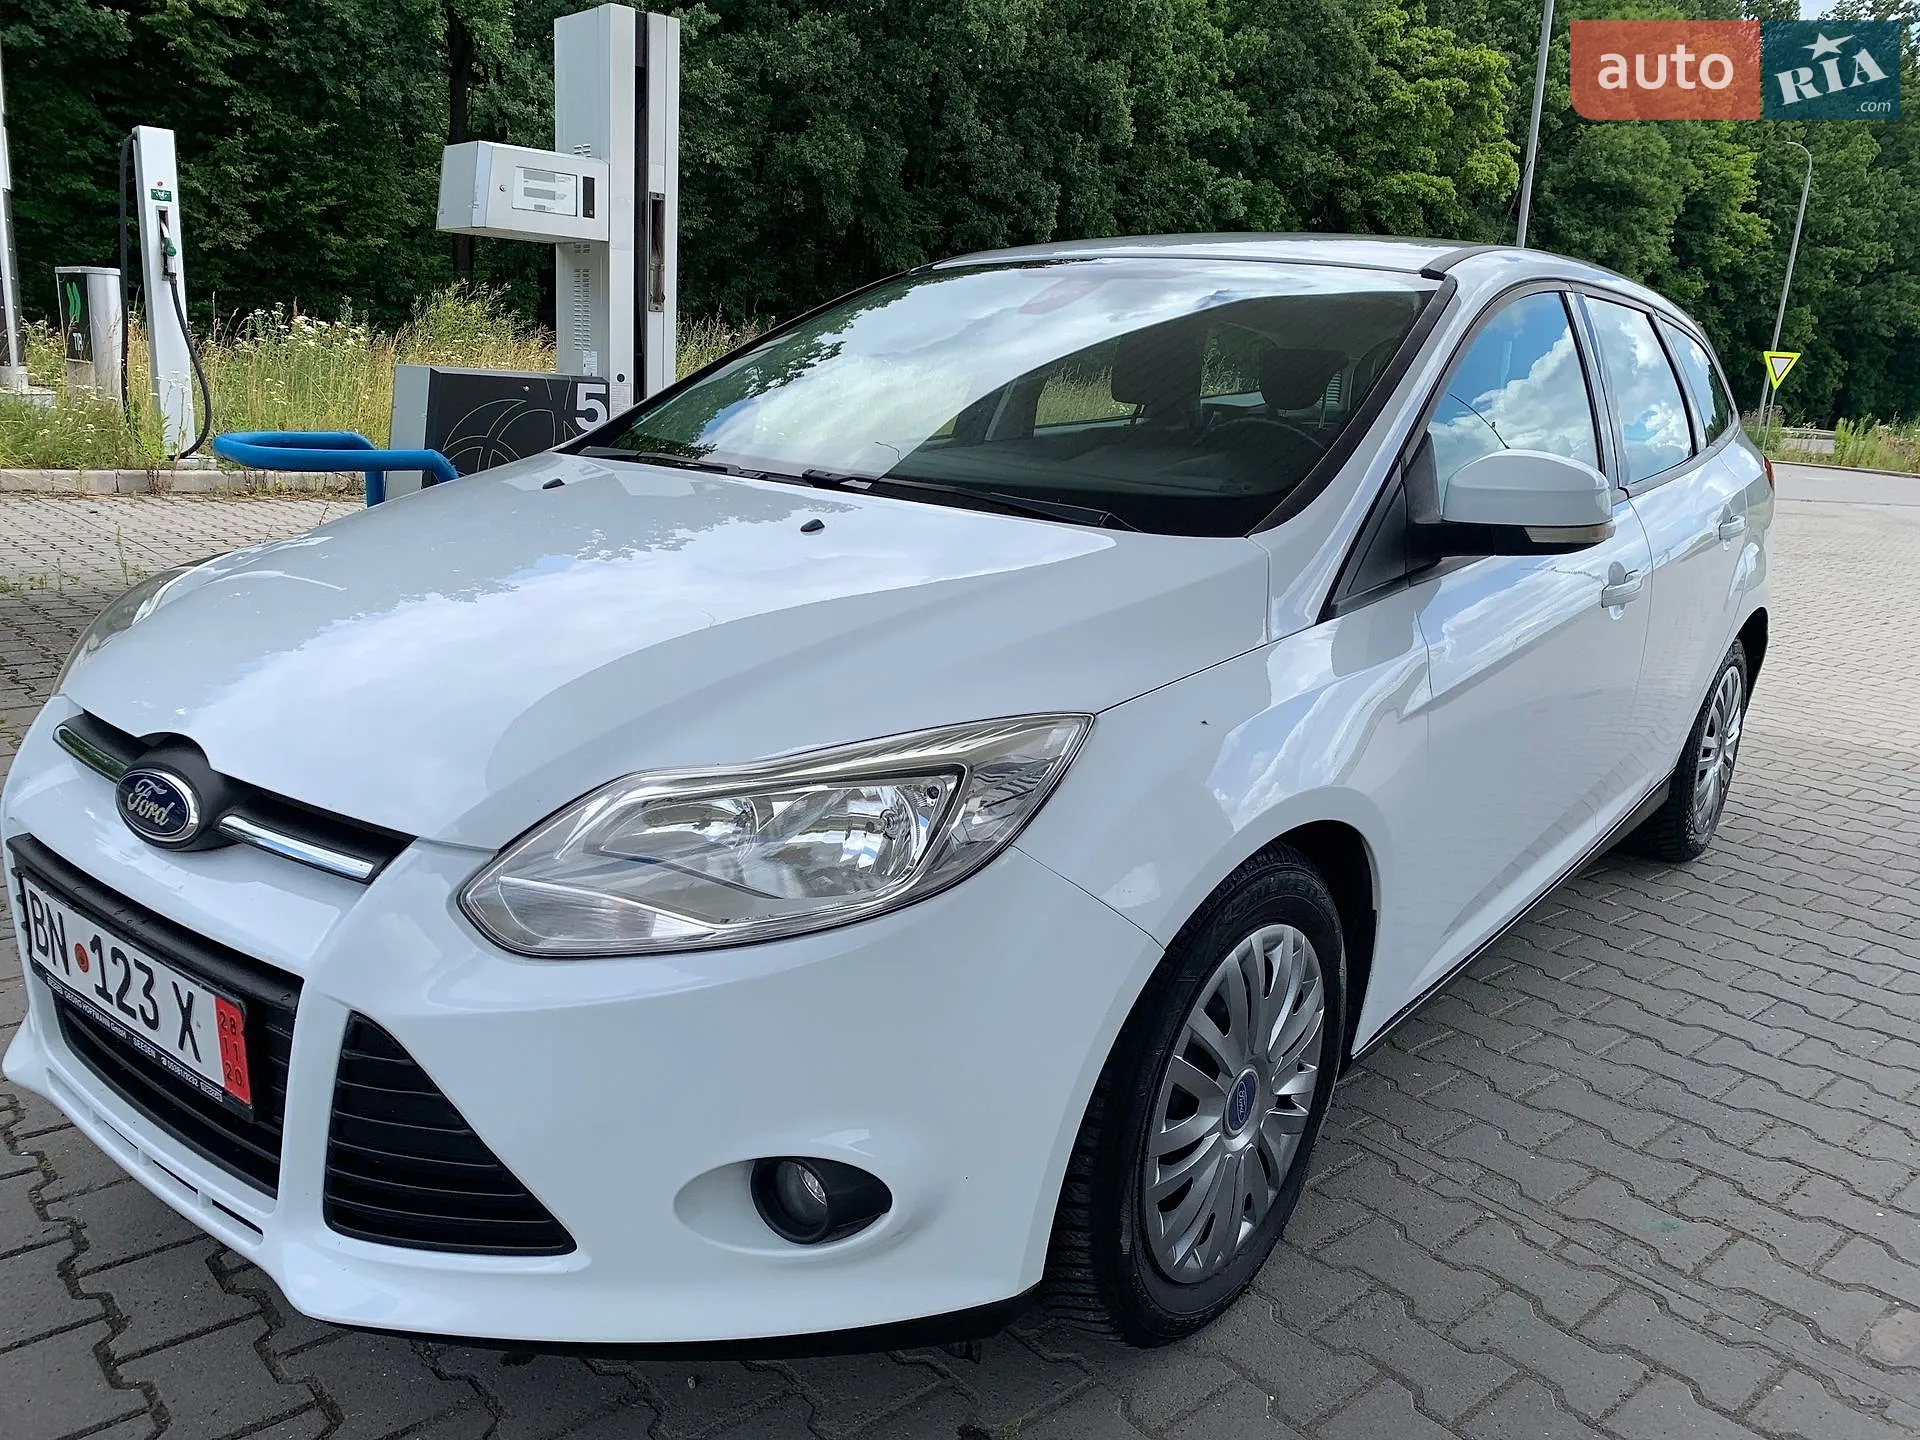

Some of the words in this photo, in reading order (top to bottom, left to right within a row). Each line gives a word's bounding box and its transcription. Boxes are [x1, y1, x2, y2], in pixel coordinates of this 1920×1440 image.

[575, 383, 608, 431] 5
[126, 778, 175, 826] Ford
[29, 889, 70, 976] BN
[89, 934, 159, 1031] 123
[172, 981, 201, 1063] X
[219, 1010, 237, 1036] 28
[223, 1036, 239, 1062] 11
[225, 1061, 243, 1088] 20
